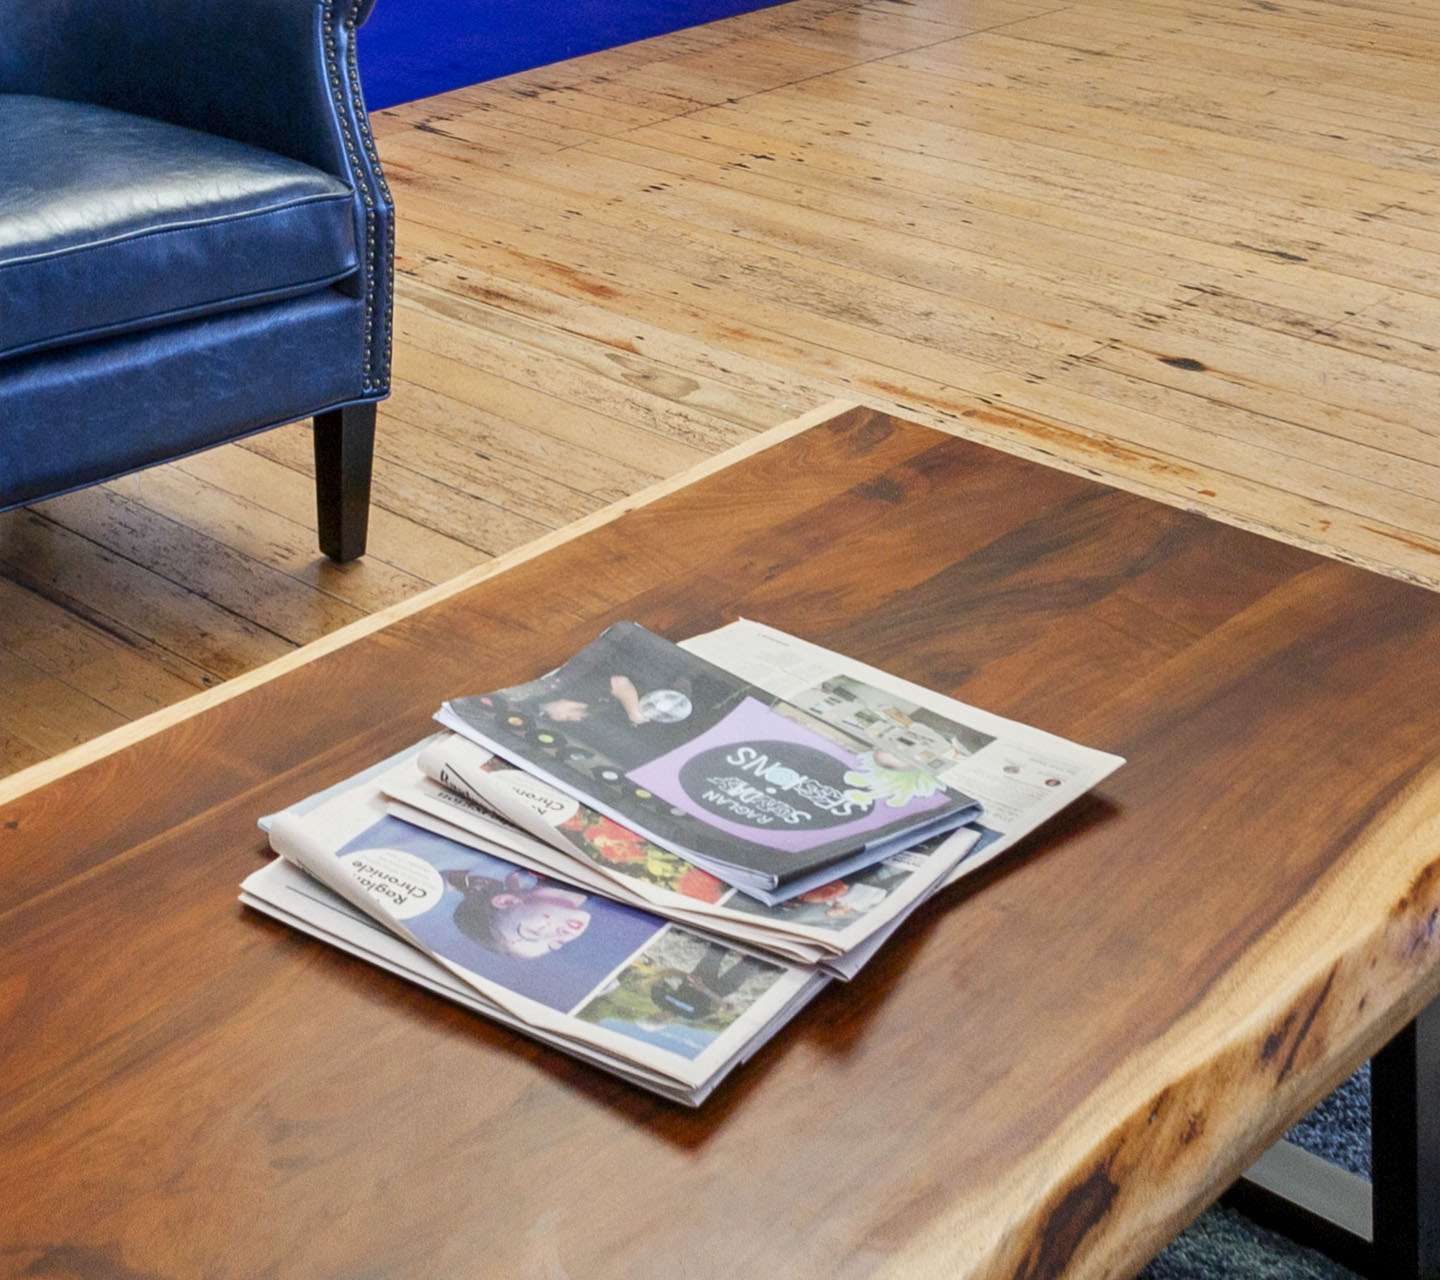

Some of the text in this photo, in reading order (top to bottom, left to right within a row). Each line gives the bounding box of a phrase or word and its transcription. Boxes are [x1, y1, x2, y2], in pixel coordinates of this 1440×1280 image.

[512, 786, 565, 811] Chron
[702, 790, 773, 824] RAGLAN
[352, 860, 428, 898] Chronicle
